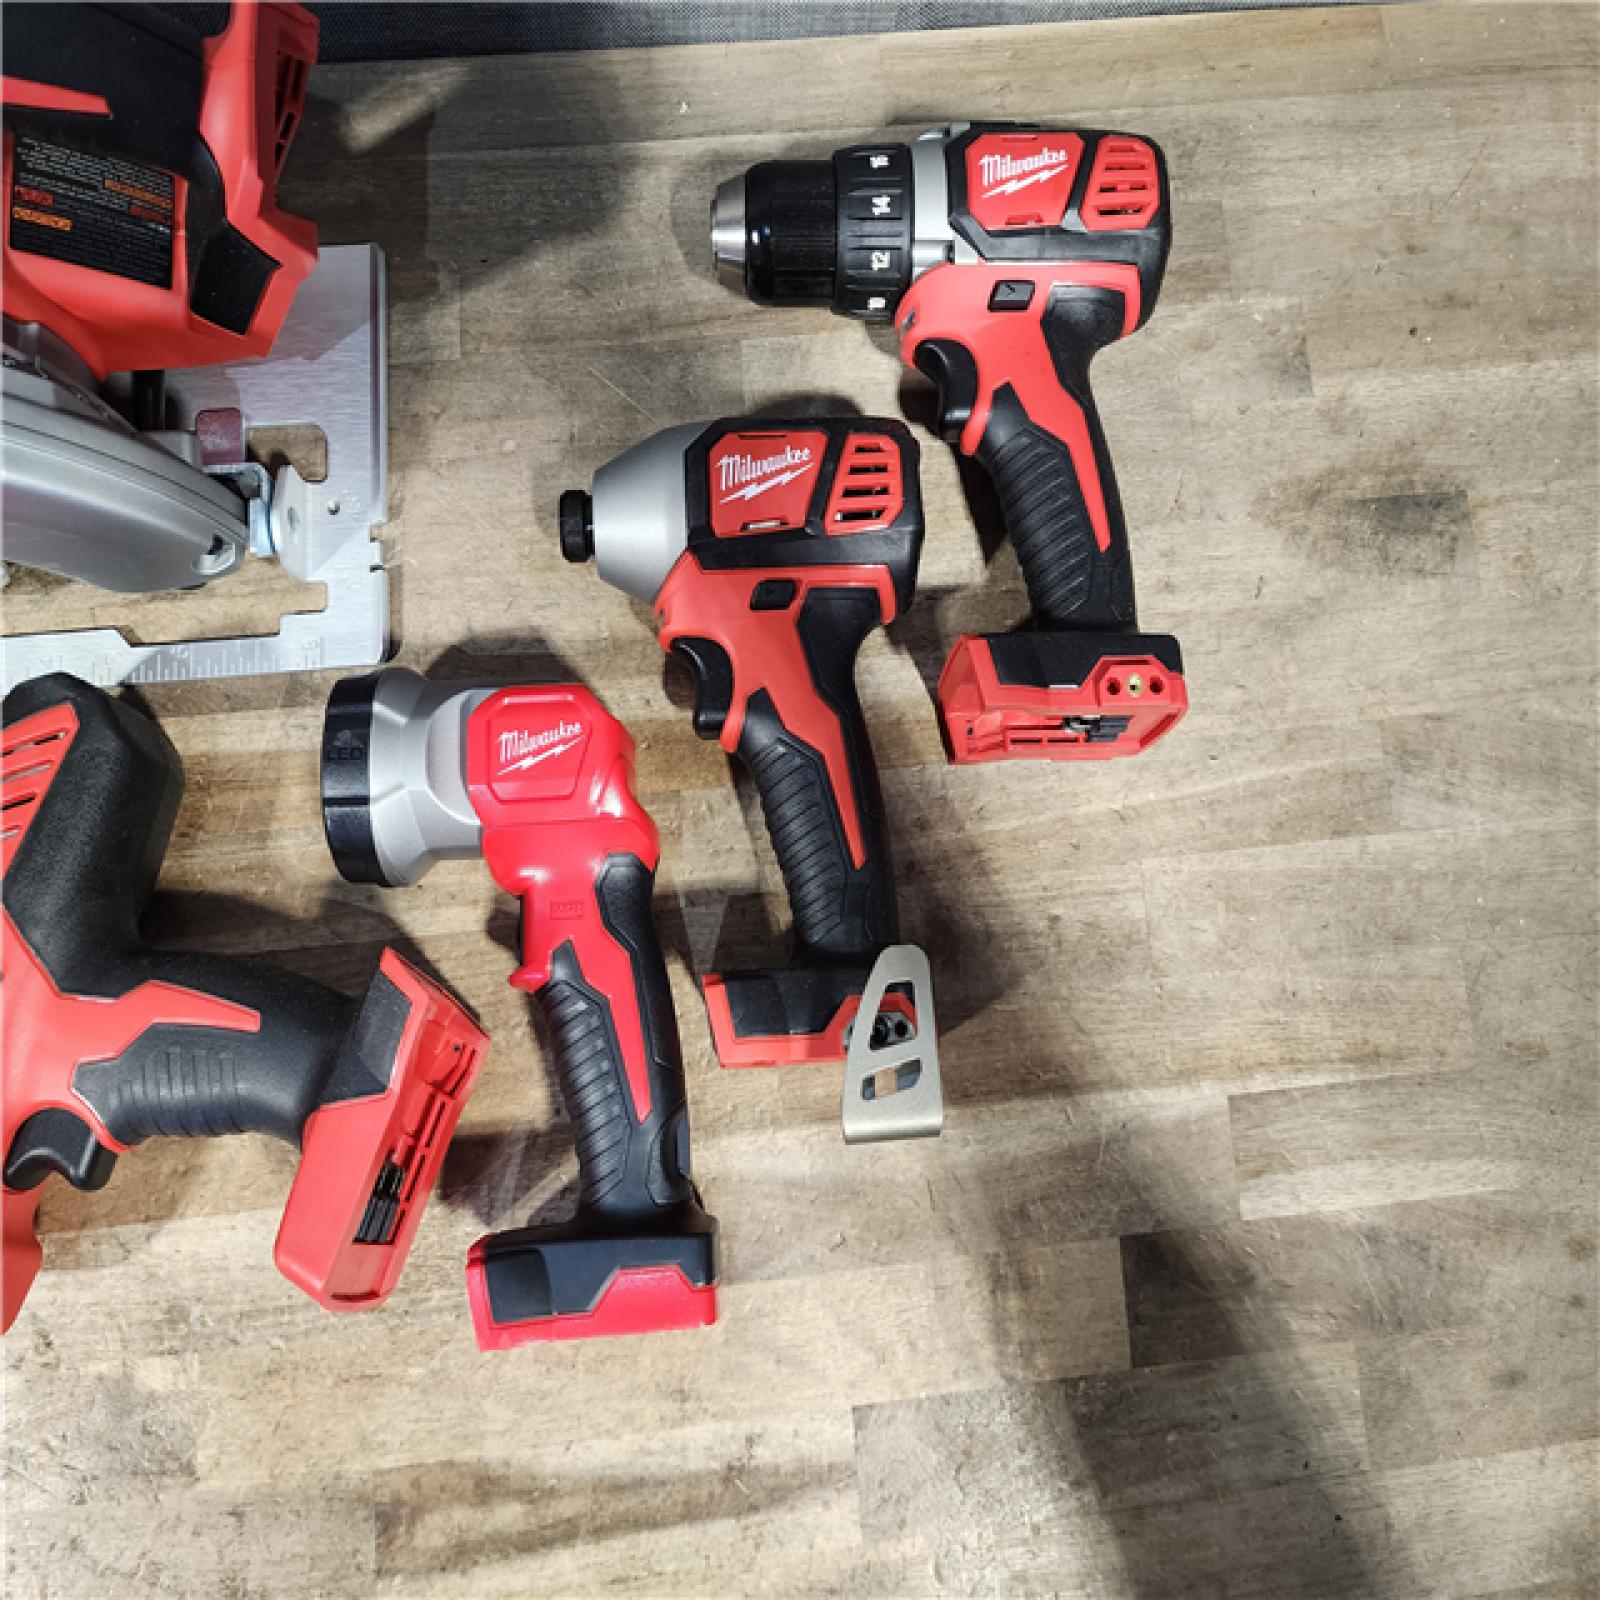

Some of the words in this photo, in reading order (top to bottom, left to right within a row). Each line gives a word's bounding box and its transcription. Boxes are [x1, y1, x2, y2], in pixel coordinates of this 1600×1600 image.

[979, 147, 1068, 187] Milwaukee
[872, 195, 890, 216] 14
[871, 251, 890, 270] 12
[715, 444, 812, 491] Milwaukee
[496, 720, 583, 763] Milwaukee
